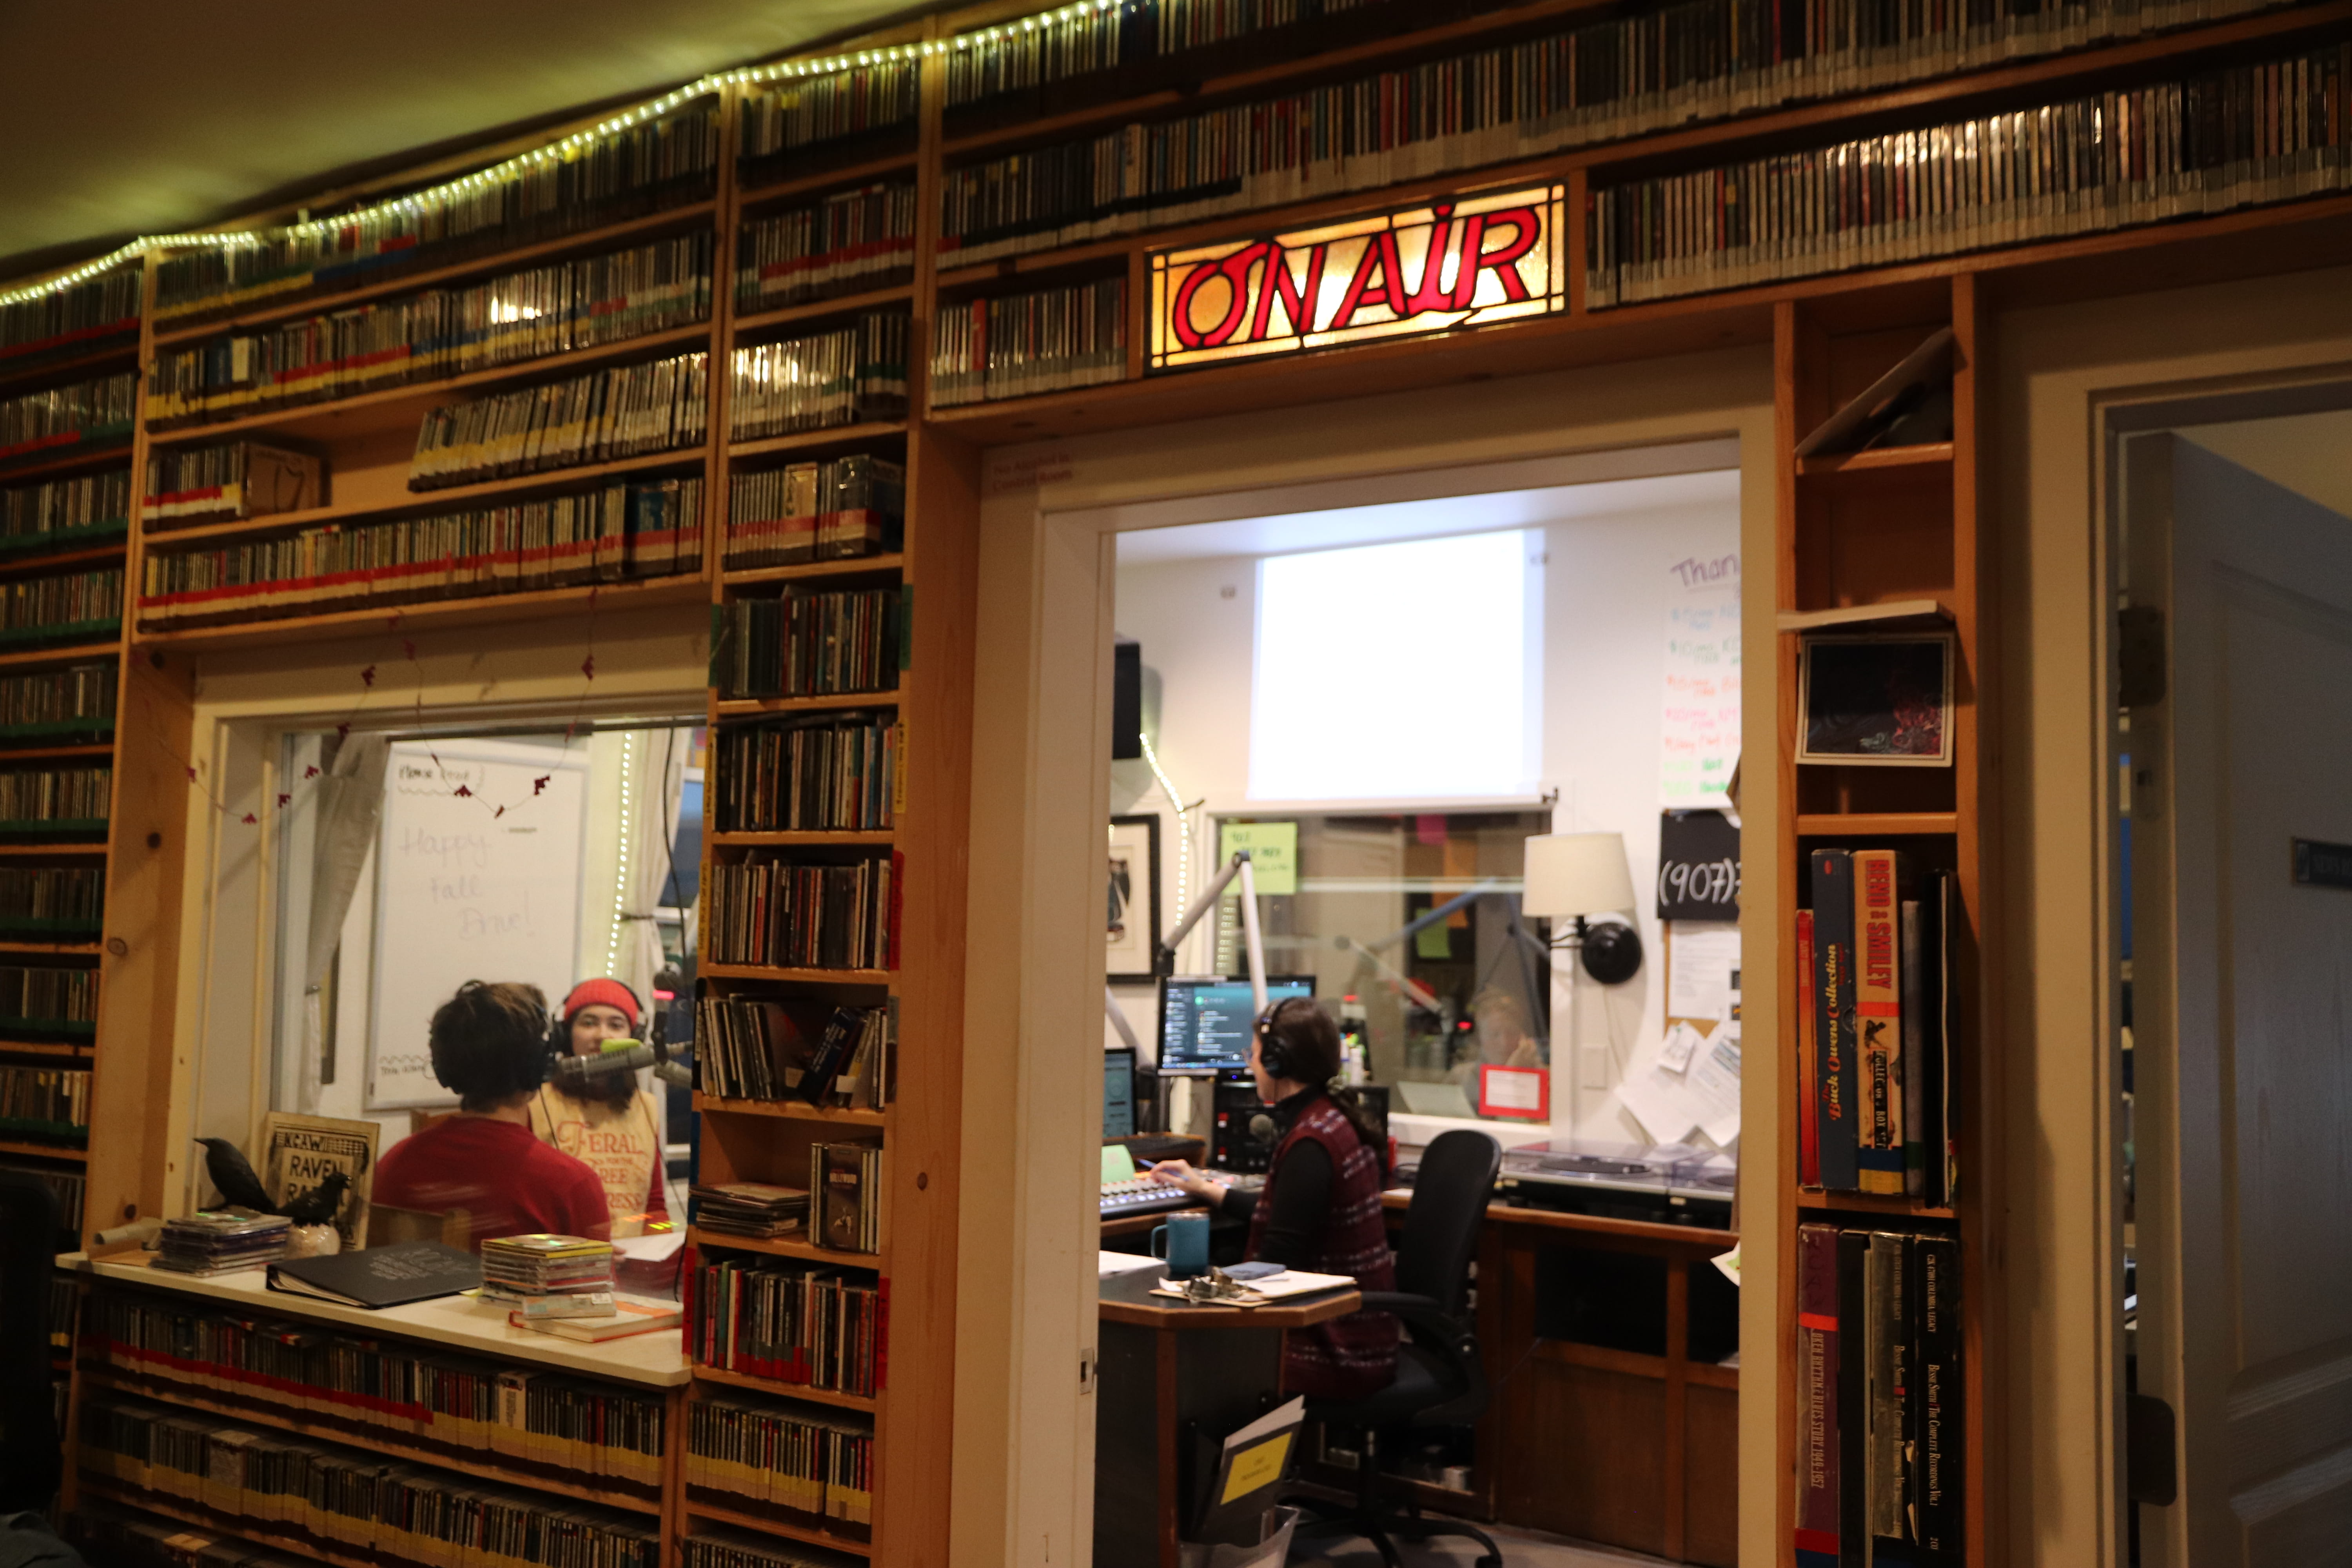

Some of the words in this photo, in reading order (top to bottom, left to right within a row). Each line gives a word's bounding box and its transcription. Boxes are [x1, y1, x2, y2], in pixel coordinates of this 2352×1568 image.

[1172, 240, 1326, 348] ON
[398, 827, 491, 869] Happy
[1865, 860, 1891, 907] RENO
[1867, 922, 1892, 989] SMILEY
[1825, 944, 1840, 1018] Collection
[1828, 1020, 1841, 1072] Owens
[1826, 1075, 1842, 1120] Buck
[1876, 1111, 1886, 1127] BOX
[557, 1120, 644, 1158] FERAL
[1812, 1356, 1824, 1388] RHYTHM
[1812, 1396, 1824, 1419] BLUES
[1928, 1384, 1940, 1403] SMITH
[1928, 1407, 1941, 1418] THE
[1812, 1421, 1824, 1446] STORY
[1928, 1420, 1941, 1451] COMPLETE
[1812, 1449, 1824, 1488] 1949-1957
[1929, 1452, 1941, 1490] RECORDINGS
